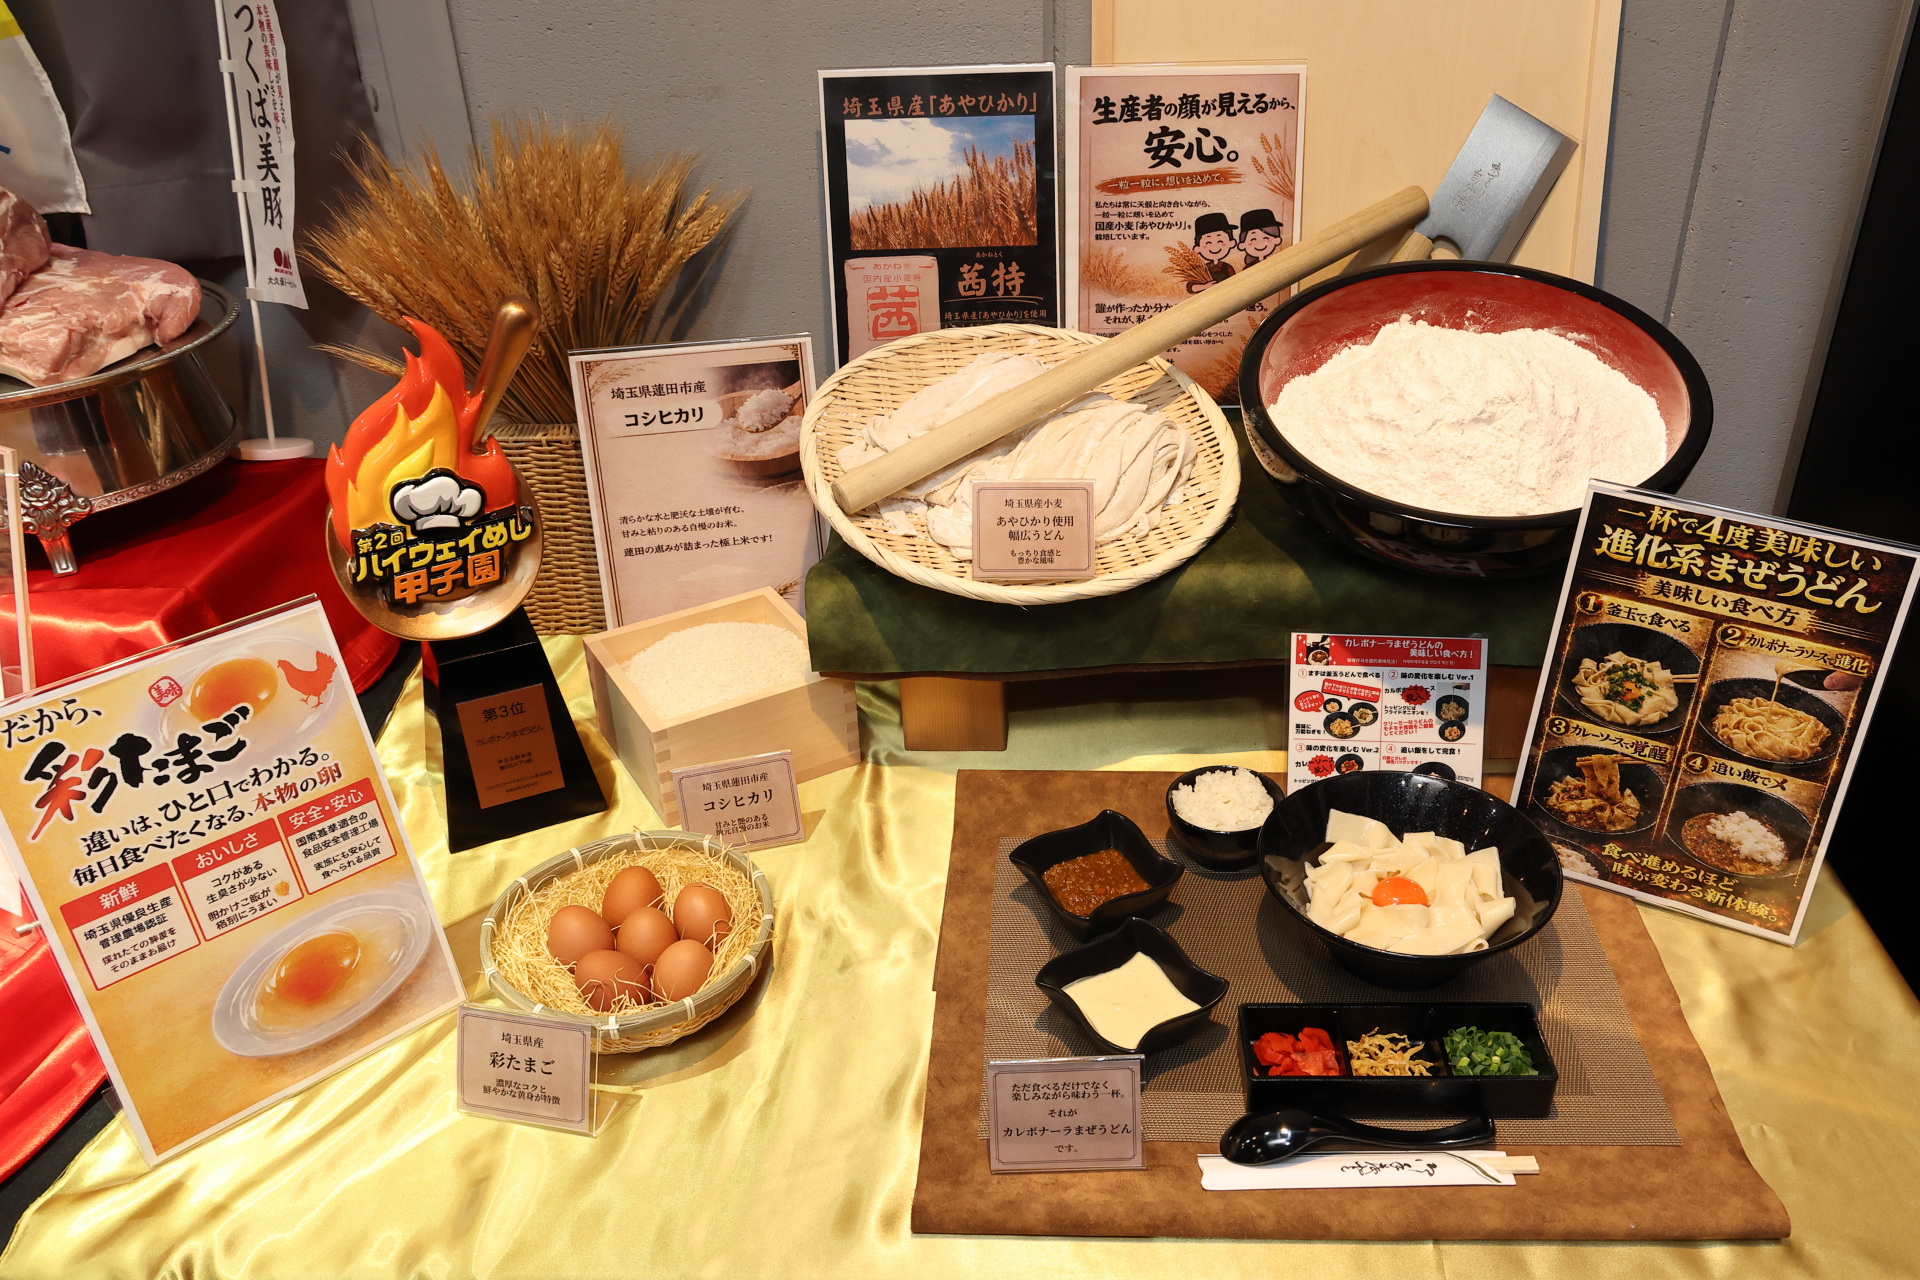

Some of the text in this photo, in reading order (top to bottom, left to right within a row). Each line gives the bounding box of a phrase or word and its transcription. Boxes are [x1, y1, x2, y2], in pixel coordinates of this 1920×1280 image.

[843, 92, 1037, 118] 埼玉県産「あやひかり」
[1092, 91, 1296, 125] 生産者の顔が見えるから、
[233, 4, 283, 230] つくば美豚
[1144, 125, 1240, 169] 安心。
[1107, 173, 1225, 190] 一粒一粒に、想いを込めて。
[1095, 221, 1192, 231] 国産小麦「あやひかり」を
[1095, 233, 1150, 241] 栽培しています。
[863, 274, 922, 283] 国内産小麦粉
[957, 261, 1026, 297] 茜特
[610, 381, 707, 400] 埼玉県蓮田市産
[624, 407, 705, 428] コシヒカリ
[618, 505, 745, 525] 清らかな水と肥沃な土壌が育む、
[1004, 498, 1063, 509] 埼玉県産小麦
[621, 519, 739, 539] 甘みと粘りのある自慢のお米。
[996, 515, 1074, 527] あやひかり使用
[357, 531, 404, 554] 第2回
[1008, 530, 1065, 541] 幅広うどん
[1617, 505, 1882, 571] 一杯で4度美味しい
[356, 518, 532, 582] ハイウェイめし
[1010, 549, 1062, 557] もっちり食感と
[1017, 557, 1055, 565] 豊かな風味
[393, 549, 500, 604] 甲子園
[1595, 523, 1883, 614] 進化系まぜうどん
[1651, 578, 1800, 626] 美味しい食べ方
[1605, 602, 1692, 633] 釜玉で食べる
[1409, 648, 1474, 658] 美味しい食べ方！
[1745, 632, 1870, 674] カルボナーラソースで進化
[1308, 670, 1381, 679] まずは釜玉うどんで食べる
[1400, 672, 1454, 680] 味の変化を楽しむ
[481, 701, 526, 722] 第3位
[0, 698, 102, 749] だから、
[1306, 744, 1359, 753] 味の変化を楽しむ
[1570, 723, 1670, 763] カレーソースで覚醒
[24, 705, 251, 841] 彩たまご
[702, 772, 769, 791] 埼玉県蓮田市産
[80, 747, 330, 856] 違いは、ひと口でわかる。
[288, 788, 364, 830] 安全・安心
[703, 789, 774, 812] コシヒカリ
[72, 762, 343, 887] 毎日食べたくなる、本物の卵
[302, 818, 380, 859] 食品安全管理工場
[194, 831, 260, 870] おいしさ
[210, 860, 264, 888] コクがある
[1601, 842, 1739, 892] 食べ進めるほど
[99, 881, 140, 911] 新鮮
[1612, 861, 1778, 923] 味が変わる新体験。
[84, 895, 173, 942] 埼玉県優良生産
[99, 913, 169, 950] 管理農場認証
[110, 938, 177, 974] そのままお届け
[501, 1031, 545, 1049] 埼玉県産
[489, 1051, 556, 1075] 彩たまご
[482, 1085, 561, 1105] 鮮やかな黄身が特徴
[495, 1078, 547, 1094] 濃厚なコクと
[1011, 1081, 1109, 1092] ただ食べるだけでなく
[1011, 1089, 1125, 1101] 楽しみながら味わう一杯。
[1048, 1109, 1078, 1118] それが
[1003, 1124, 1132, 1138] カレボナーラまぜうどん
[1055, 1144, 1078, 1153] です。
